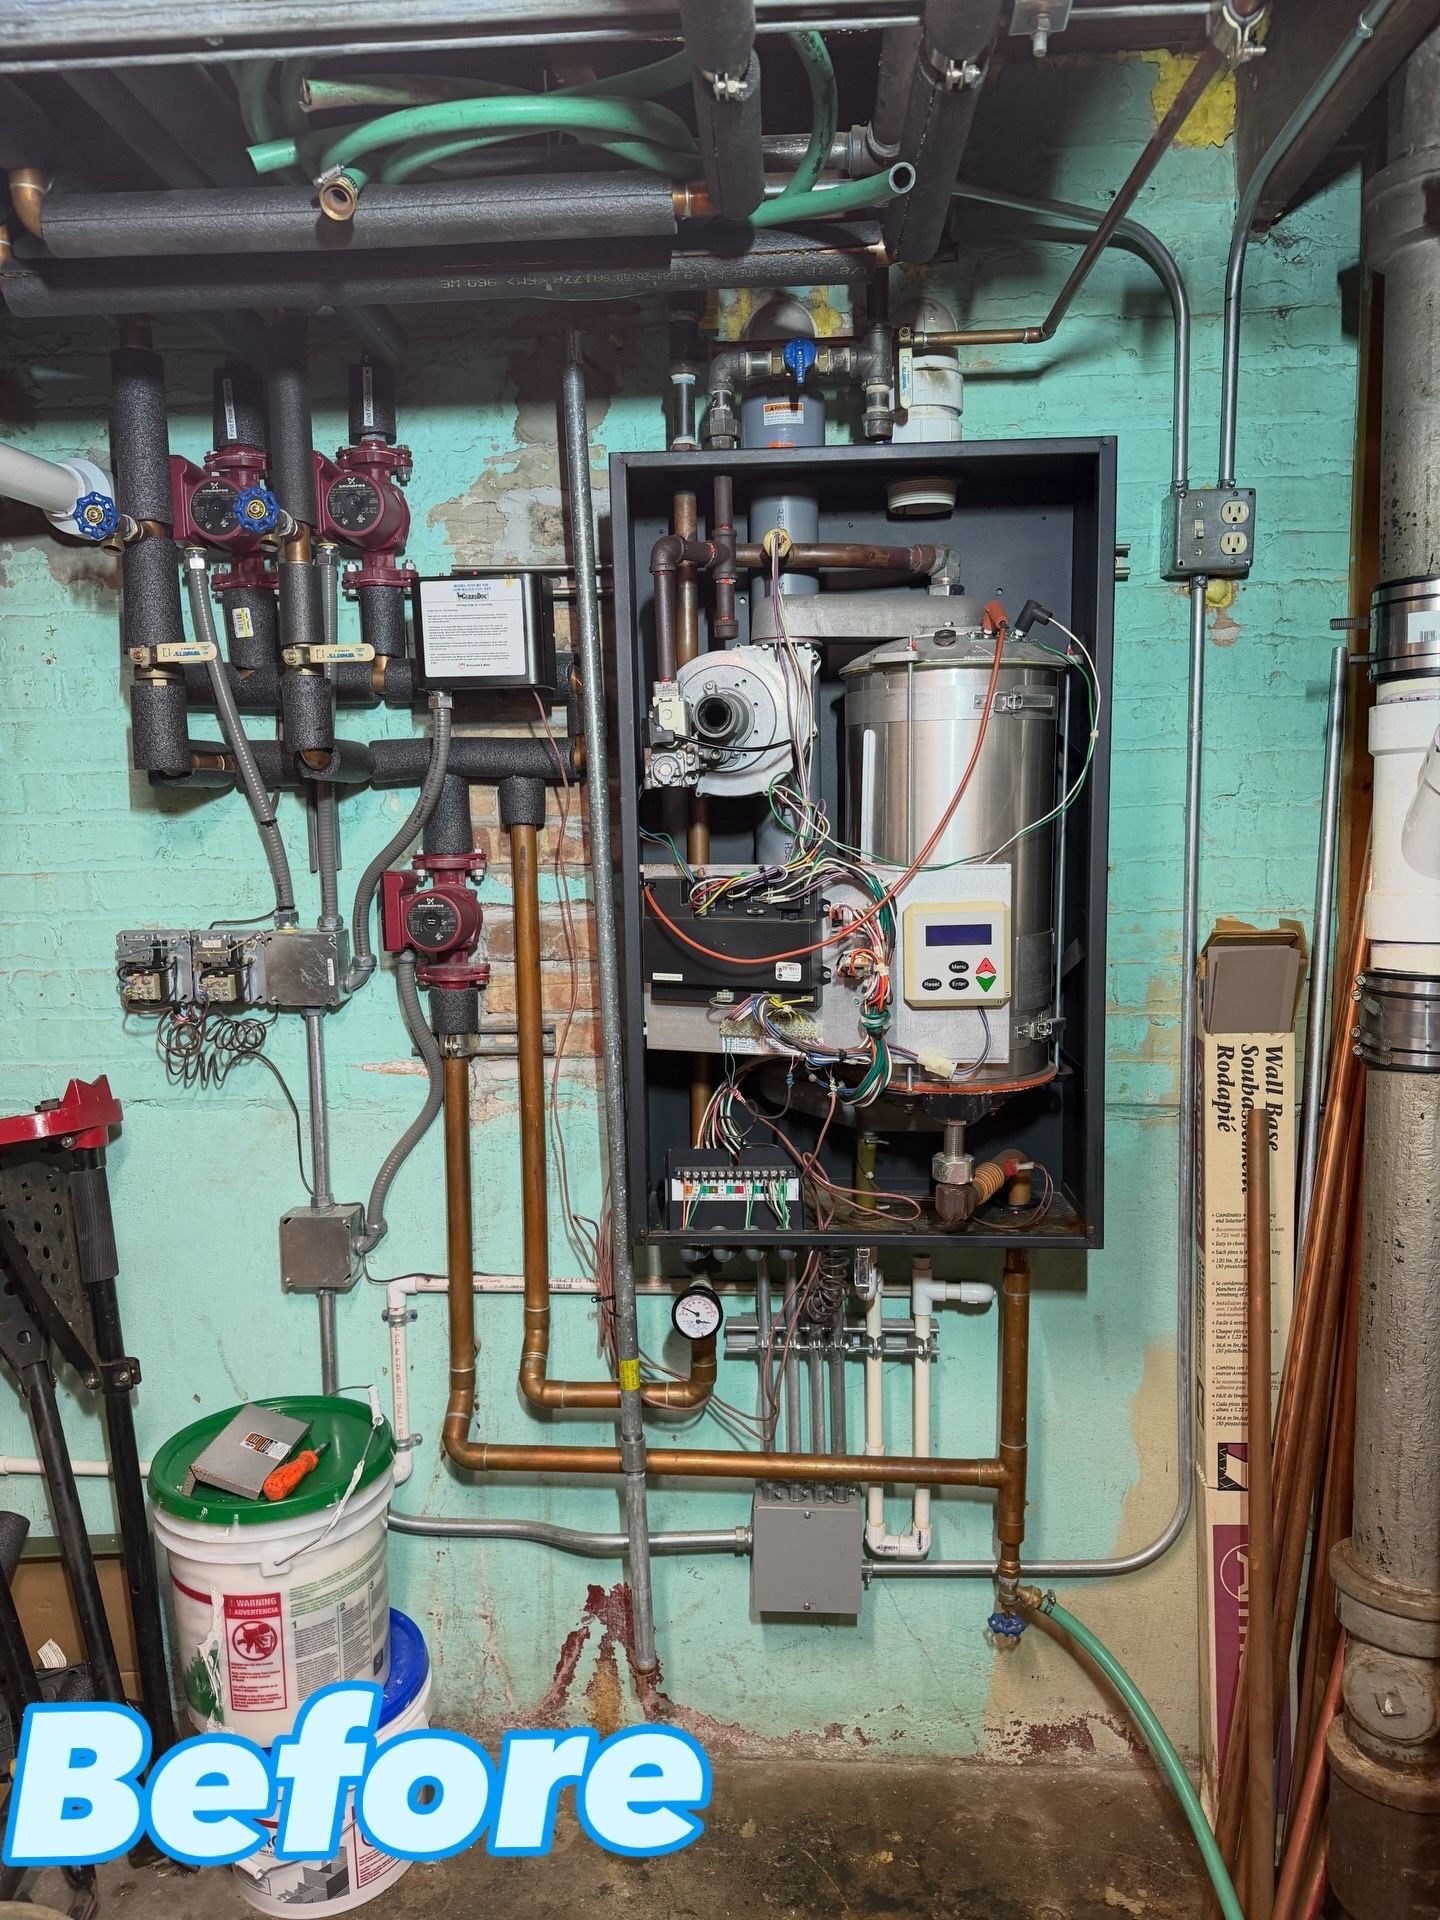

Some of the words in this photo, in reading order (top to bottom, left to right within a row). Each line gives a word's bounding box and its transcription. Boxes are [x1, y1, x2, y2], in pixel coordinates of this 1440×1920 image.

[1265, 1045, 1283, 1095] Wall
[1212, 1043, 1236, 1132] Rodapié
[236, 1597, 277, 1608] WARNING
[339, 1602, 346, 1612] 2
[234, 1607, 279, 1617] ADVERTENCIA
